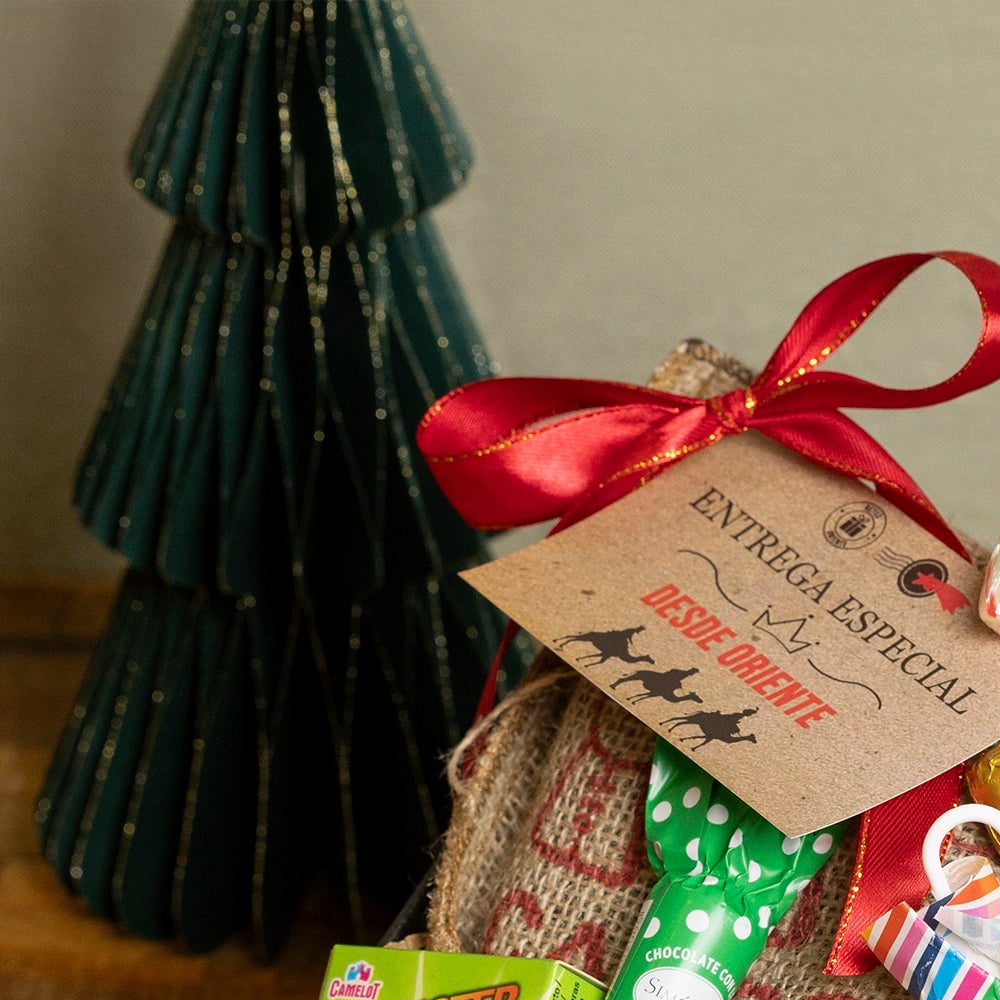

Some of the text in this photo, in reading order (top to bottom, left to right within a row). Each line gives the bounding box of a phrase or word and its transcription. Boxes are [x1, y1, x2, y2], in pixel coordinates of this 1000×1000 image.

[690, 488, 982, 716] ENTREGA ESPECIAL
[641, 583, 838, 730] DESDE ORIENTE
[329, 978, 381, 1000] CAMELOT
[645, 946, 722, 976] CHOCOLATE
